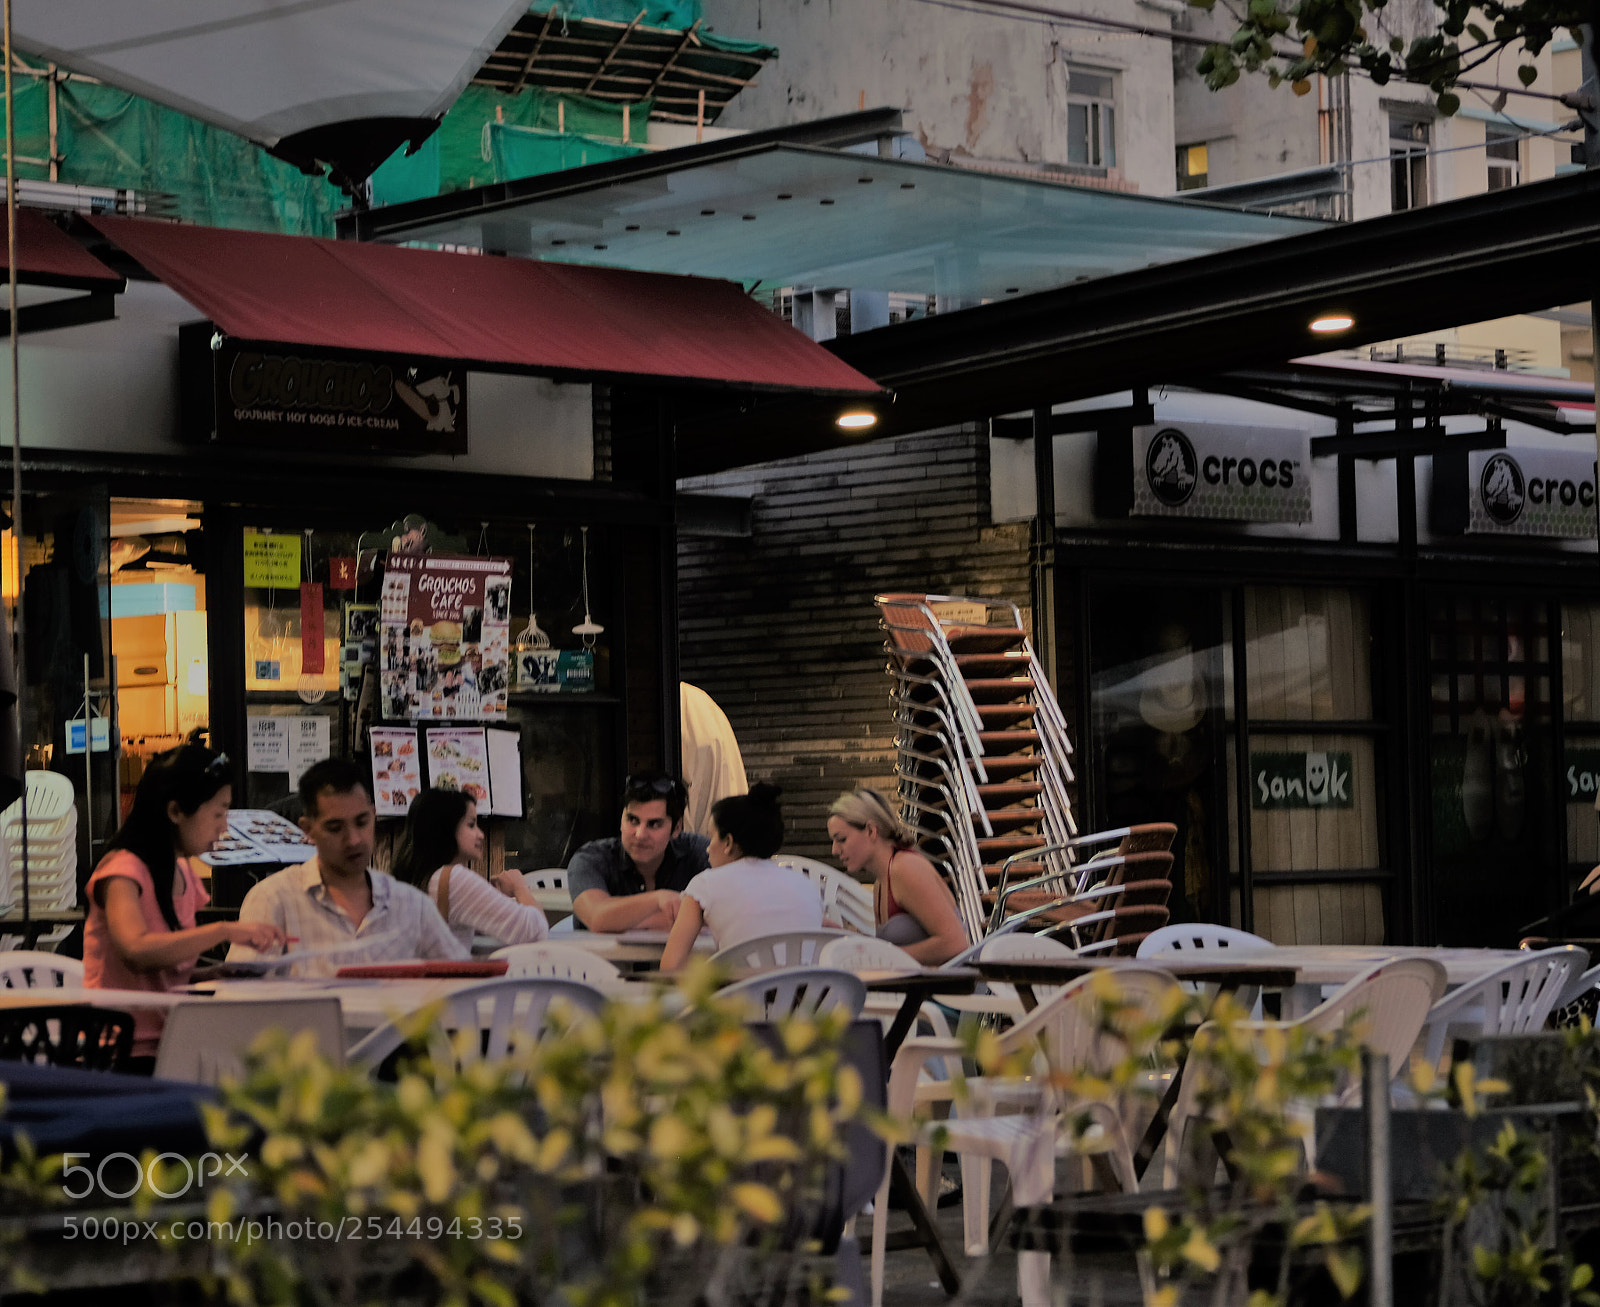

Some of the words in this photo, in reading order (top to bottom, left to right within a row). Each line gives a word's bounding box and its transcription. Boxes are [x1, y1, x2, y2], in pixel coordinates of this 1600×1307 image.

[230, 351, 393, 414] GROUCHOS
[233, 408, 284, 422] GOURMET
[286, 411, 307, 424] HOT
[309, 413, 336, 427] DOGS
[337, 413, 345, 426] &
[346, 415, 400, 431] ICE-CREAM
[1528, 477, 1594, 507] croc
[417, 573, 476, 595] GROUCHOS
